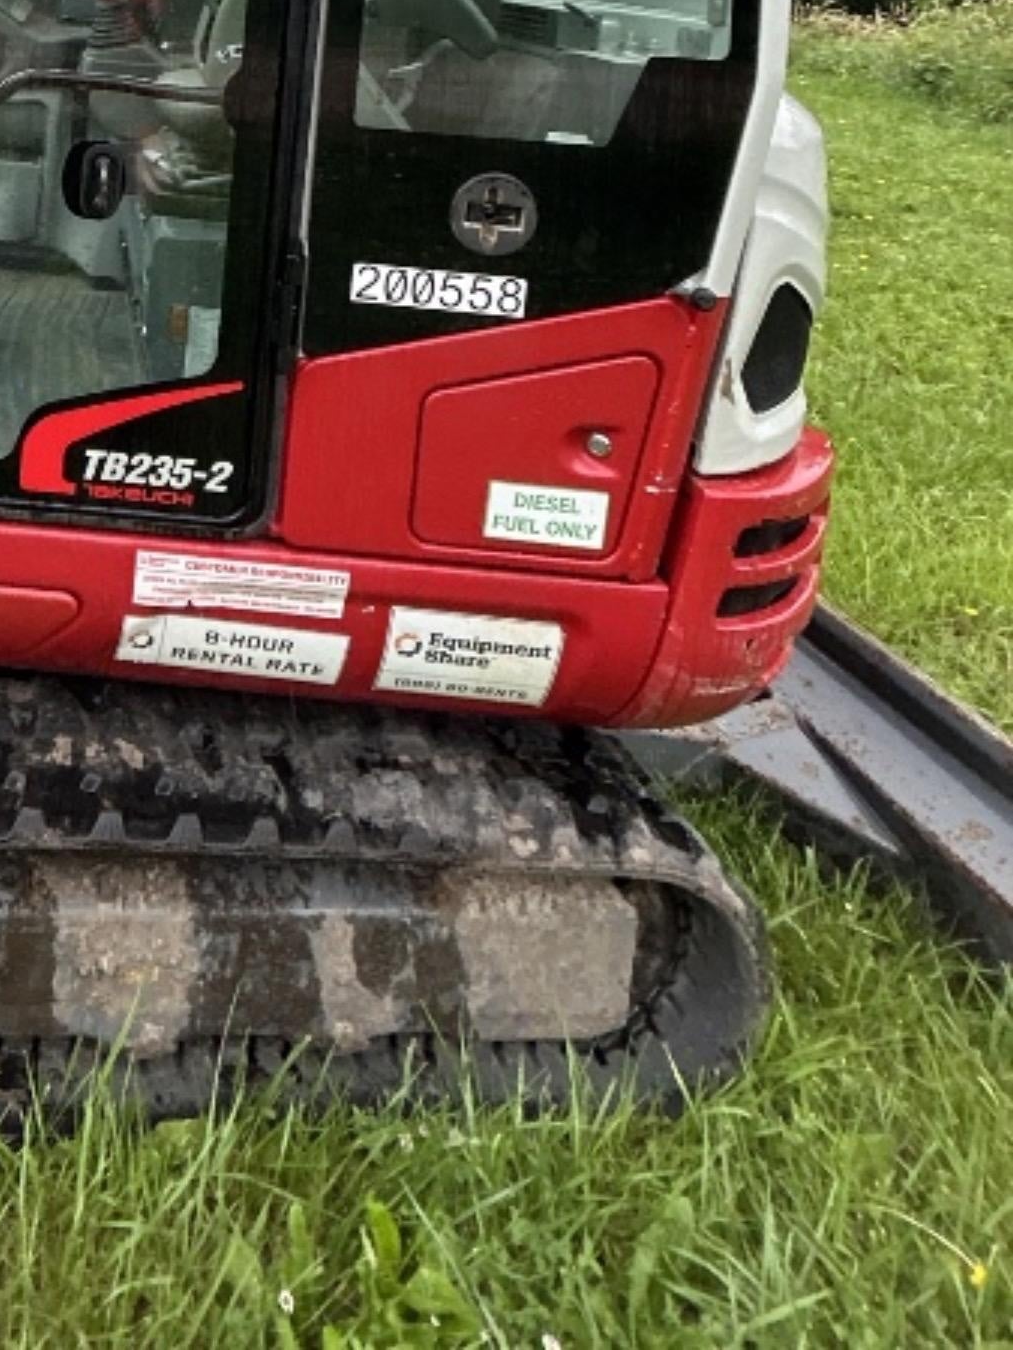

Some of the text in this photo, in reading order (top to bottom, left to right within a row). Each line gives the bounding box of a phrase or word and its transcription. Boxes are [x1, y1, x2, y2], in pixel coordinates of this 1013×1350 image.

[356, 266, 522, 313] 200558
[83, 449, 234, 493] TB235-2
[83, 483, 195, 507] TAKEUCHI
[514, 492, 580, 514] DIESEL
[492, 514, 597, 541] FUEL ONLY
[204, 629, 295, 655] 8-HOUR
[428, 633, 552, 660] Equipment
[170, 646, 325, 676] RENTAL RATE
[424, 649, 490, 669] Share
